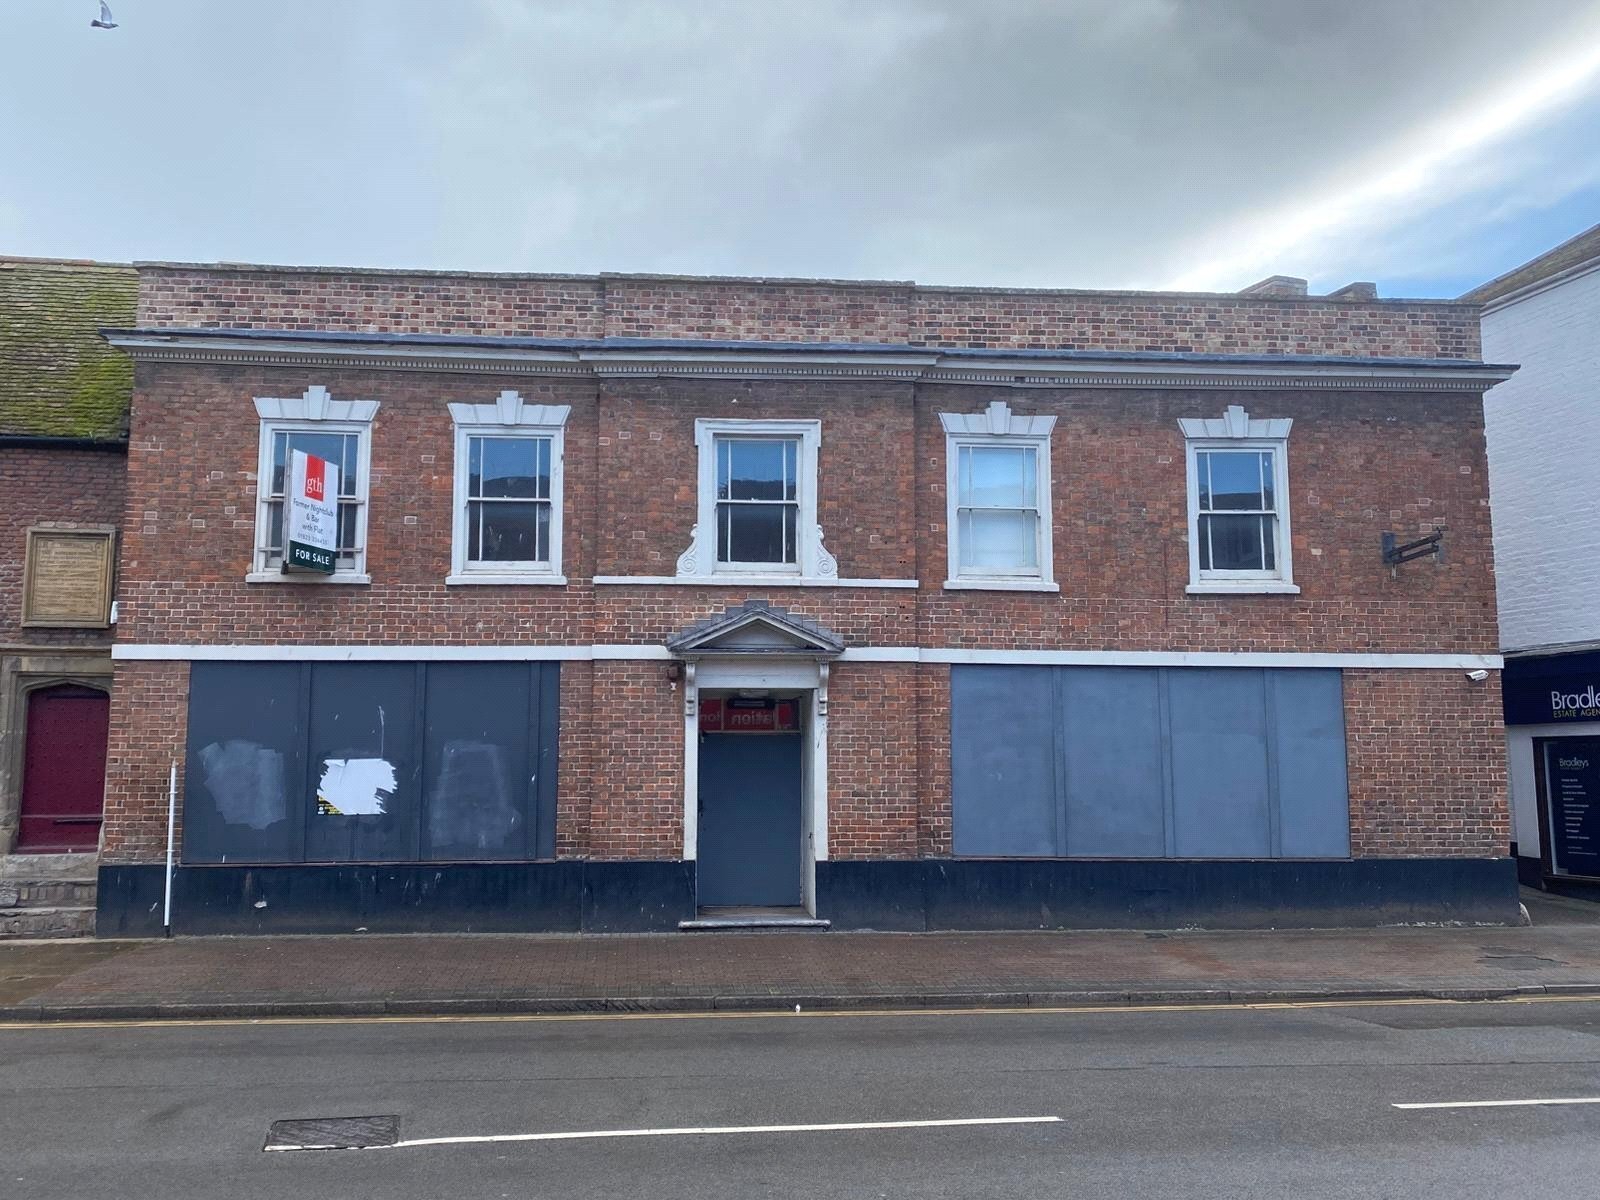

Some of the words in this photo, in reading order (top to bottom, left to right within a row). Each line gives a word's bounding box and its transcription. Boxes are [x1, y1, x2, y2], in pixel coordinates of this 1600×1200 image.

[307, 477, 323, 494] gth
[311, 514, 320, 523] Bar
[295, 549, 310, 560] FOR
[312, 553, 330, 565] SALE
[1553, 710, 1576, 718] ESTATE
[1559, 757, 1589, 768] Bradleys
